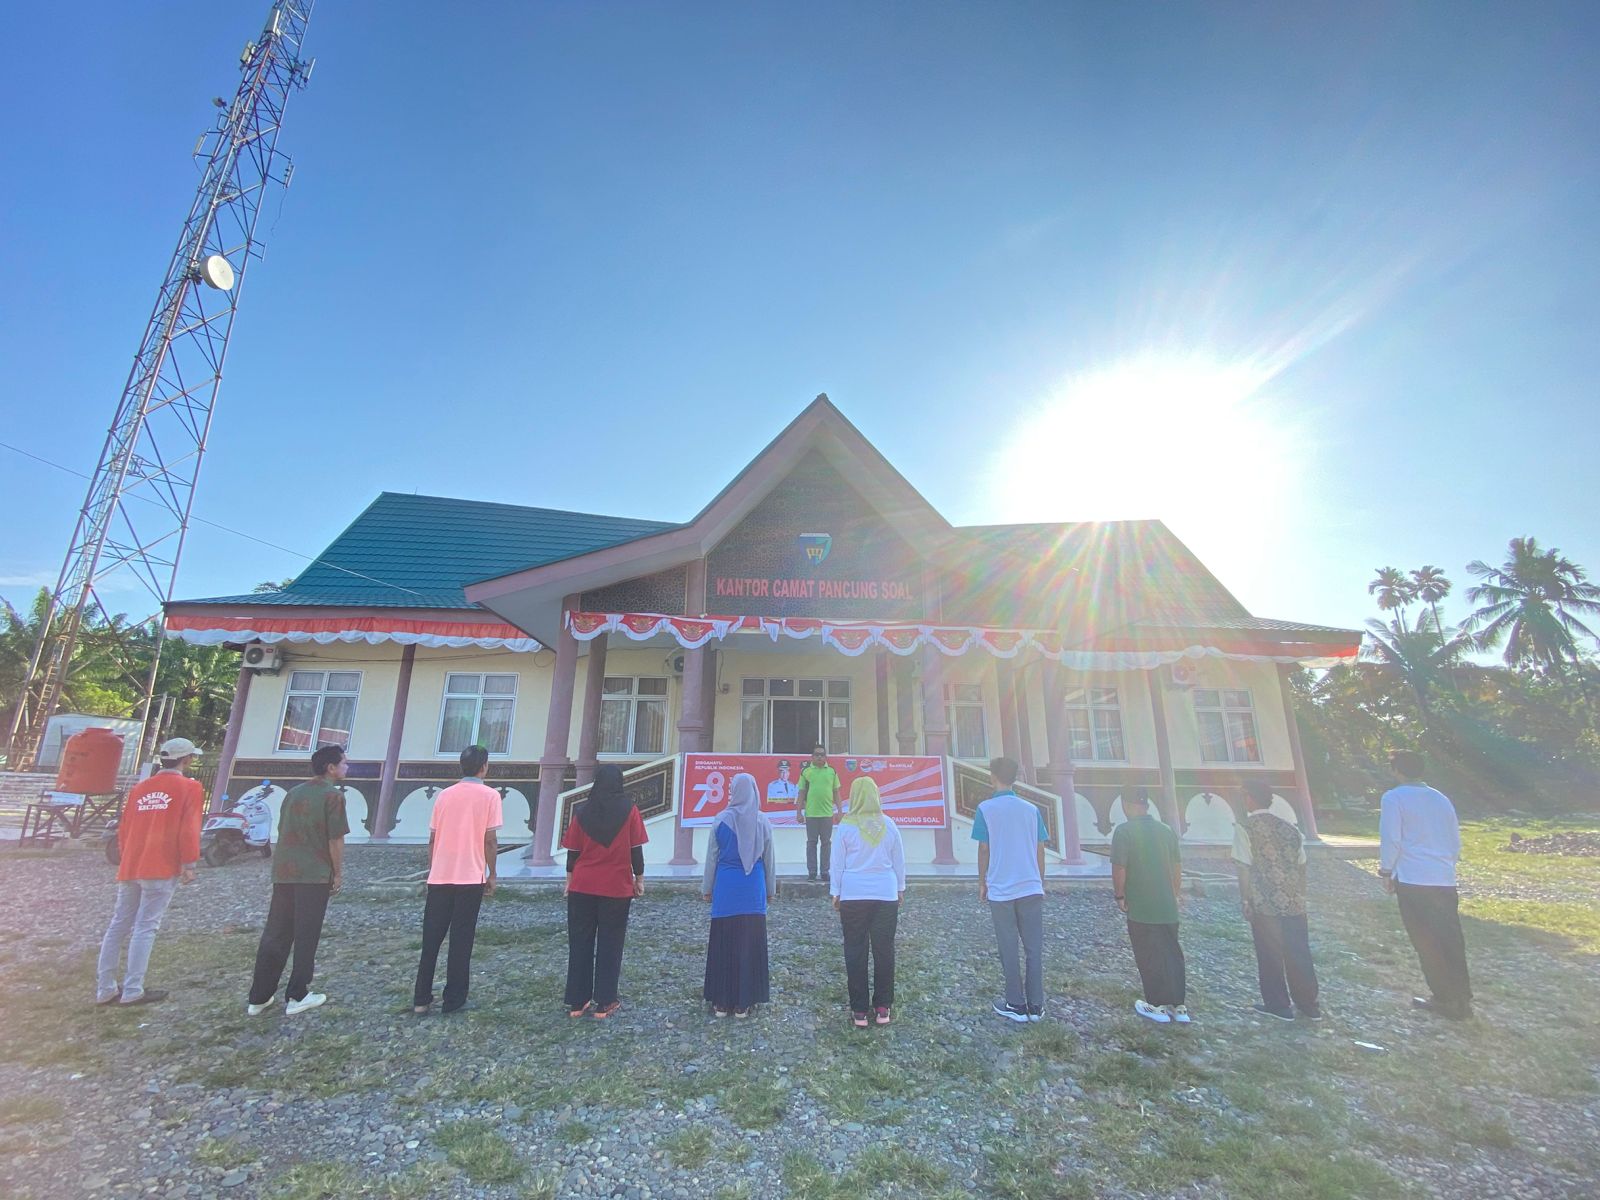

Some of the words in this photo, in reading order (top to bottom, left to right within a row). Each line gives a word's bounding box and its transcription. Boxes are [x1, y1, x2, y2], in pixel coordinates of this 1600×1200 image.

[716, 578, 769, 597] KANTOR
[773, 579, 815, 598] CAMAT
[818, 580, 878, 599] PANCUNG
[882, 581, 913, 600] SOAL
[692, 771, 725, 812] 78
[891, 815, 922, 823] PANCUNG
